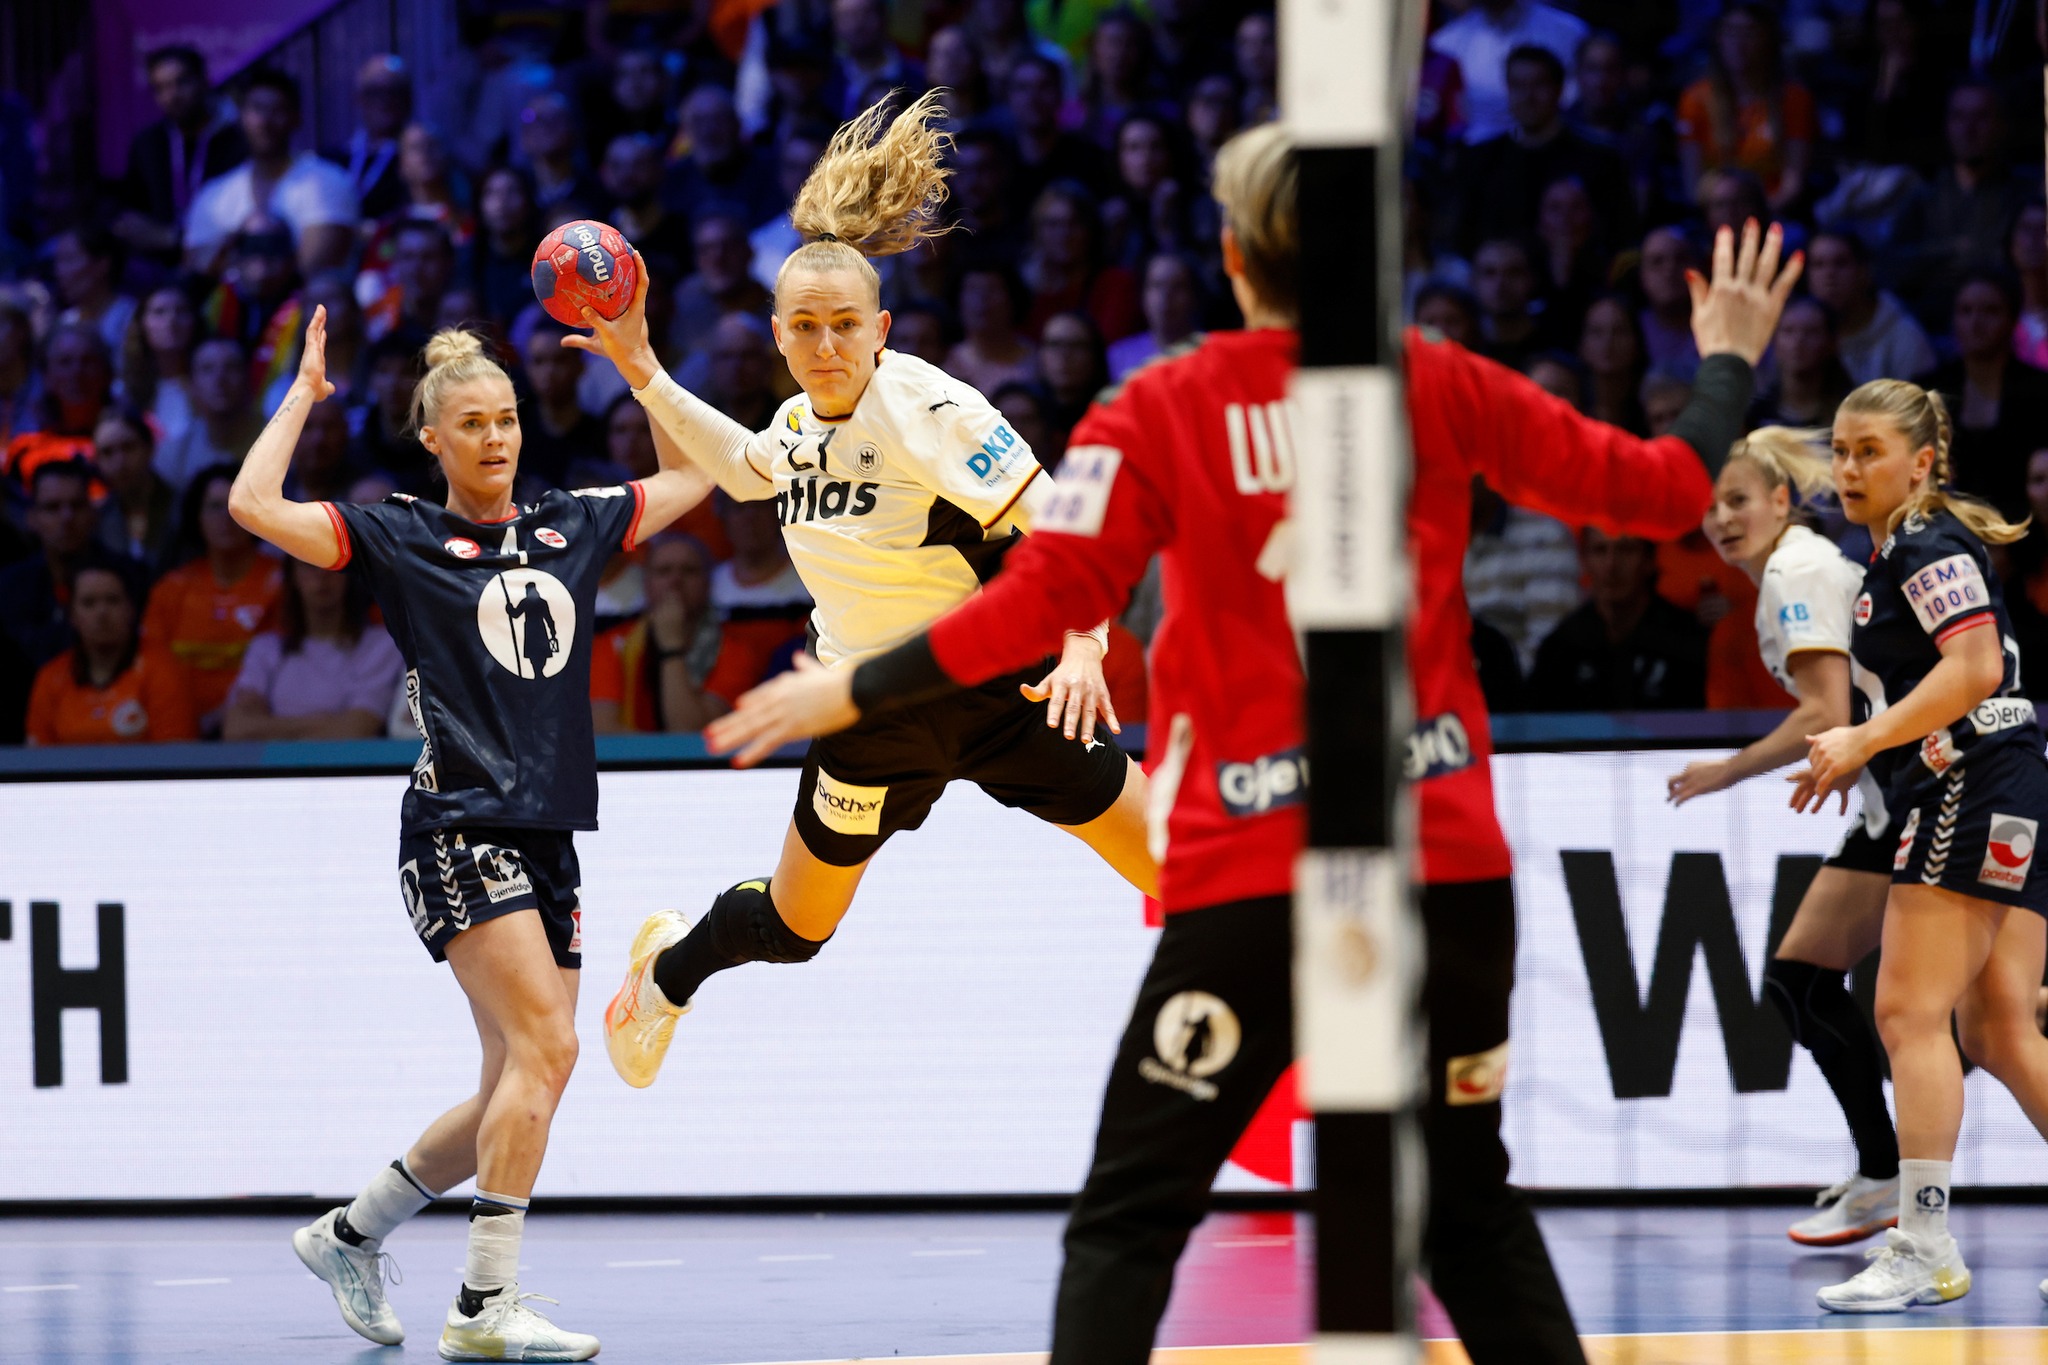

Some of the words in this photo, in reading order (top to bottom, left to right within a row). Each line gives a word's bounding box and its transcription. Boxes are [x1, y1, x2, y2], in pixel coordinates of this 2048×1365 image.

[573, 225, 609, 282] molten
[966, 425, 1015, 479] DKB
[1224, 402, 1295, 495] LU
[777, 476, 881, 527] atlas
[1907, 560, 1978, 601] REMA
[1779, 603, 1809, 626] KB
[1925, 586, 1978, 622] 1000
[1974, 702, 2034, 730] Gjen
[818, 780, 881, 812] brother
[455, 833, 466, 851] 4
[489, 882, 531, 900] Gjensidige
[1981, 868, 2025, 884] posten
[1560, 850, 1975, 1099] W
[0, 901, 128, 1087] H
